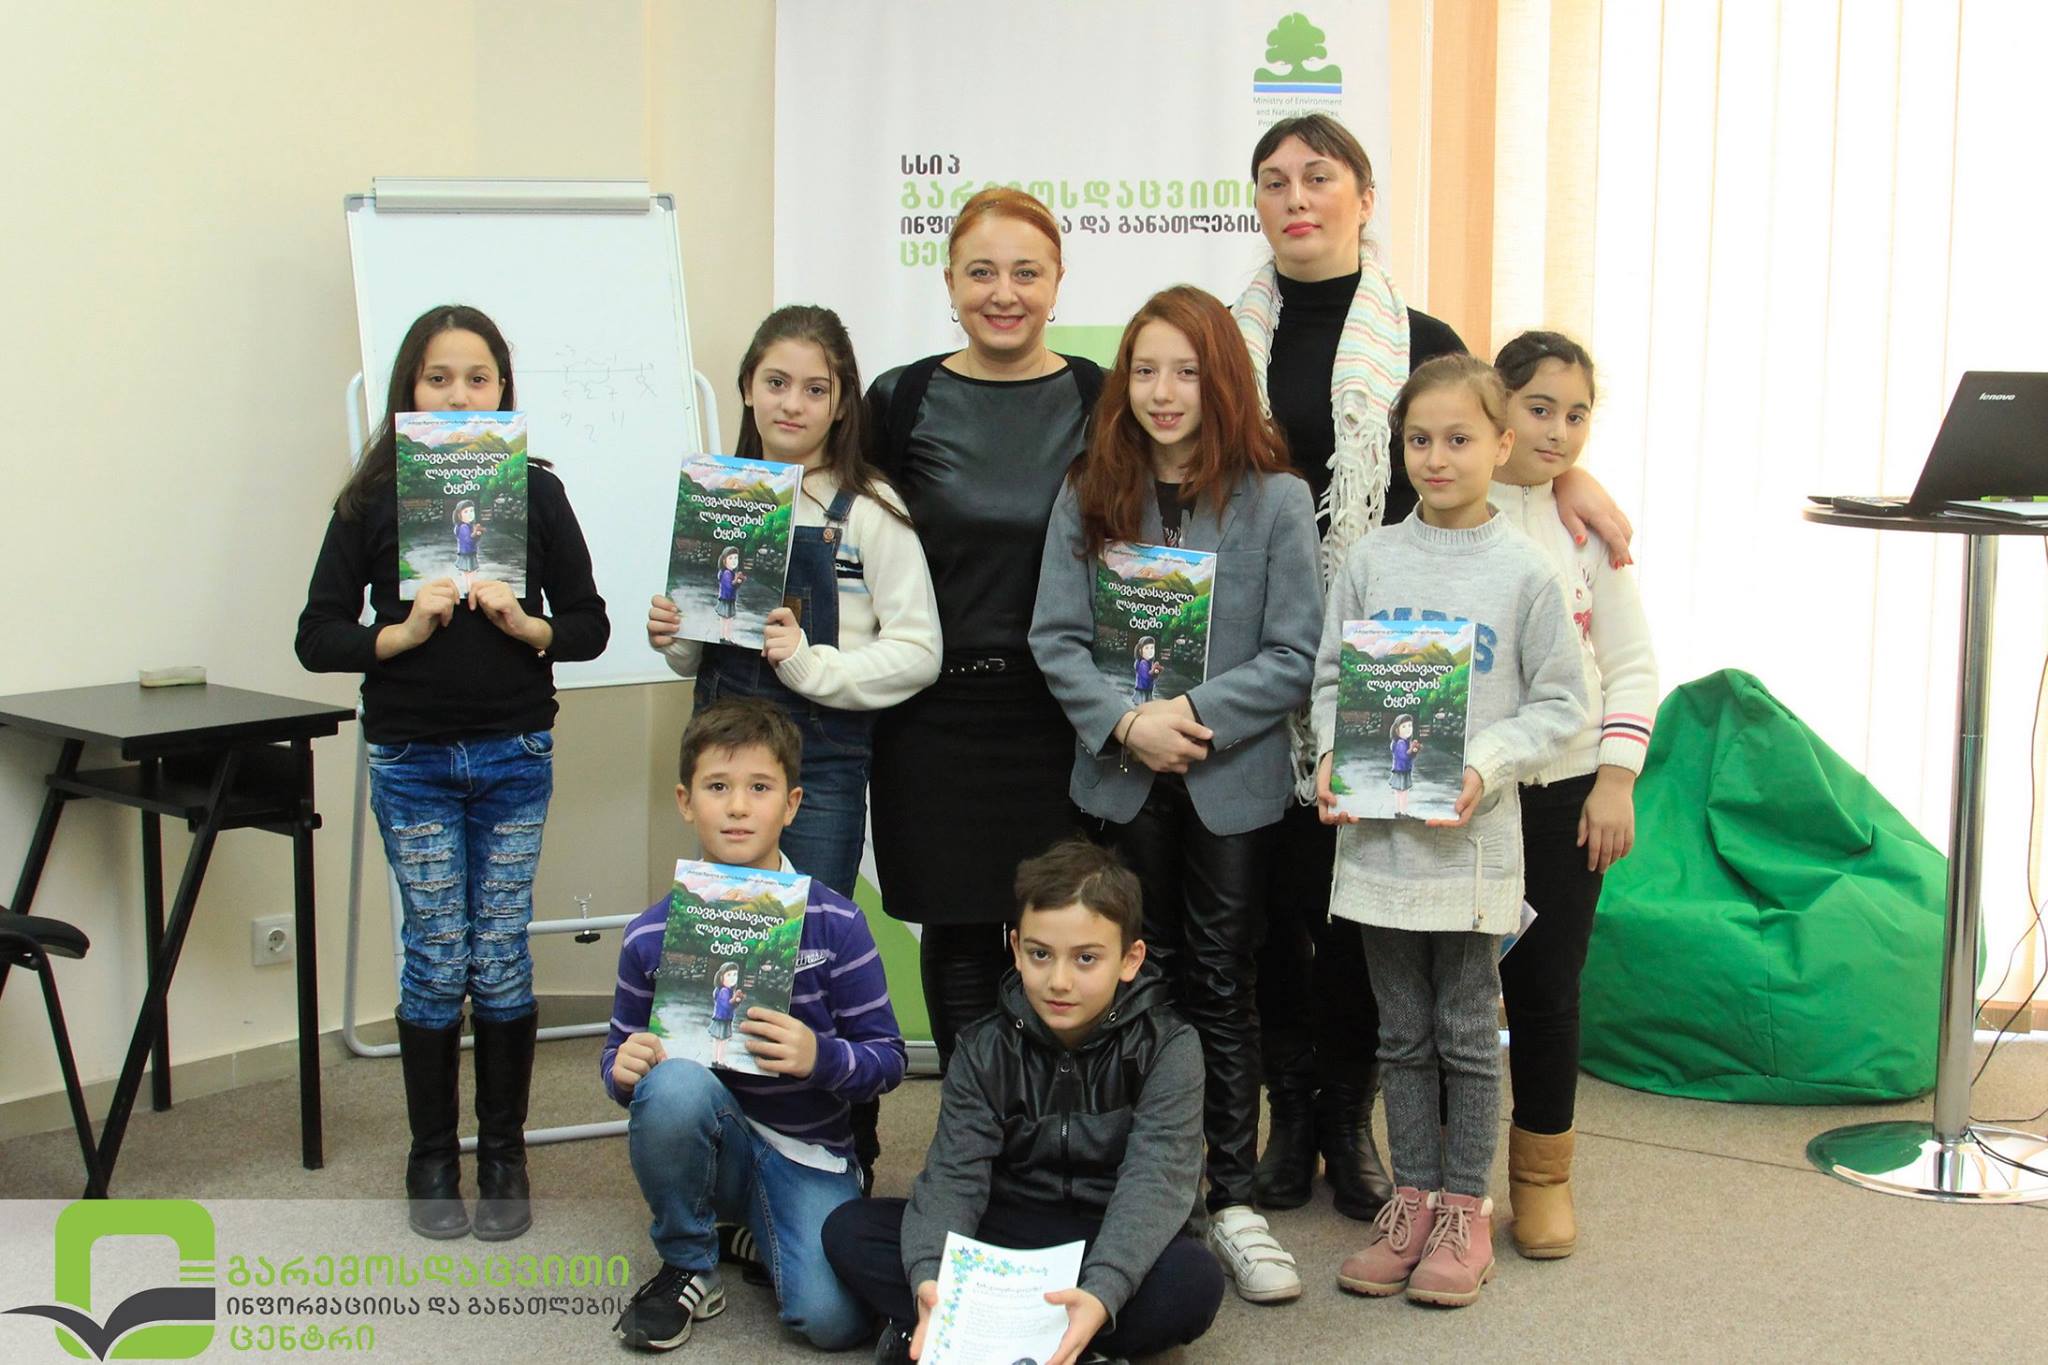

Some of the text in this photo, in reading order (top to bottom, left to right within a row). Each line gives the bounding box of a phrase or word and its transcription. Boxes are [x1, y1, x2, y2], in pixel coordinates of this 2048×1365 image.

[1080, 215, 1110, 233] და
[1118, 214, 1261, 233] განათლების
[1979, 391, 2016, 401] lenovo
[413, 450, 510, 465] თავგადასავალი
[691, 494, 777, 513] თავგადასავალი
[1108, 582, 1195, 604] თავგადასავალი
[1356, 661, 1454, 676] თავგადასავალი
[687, 905, 785, 928] თავგადასავალი
